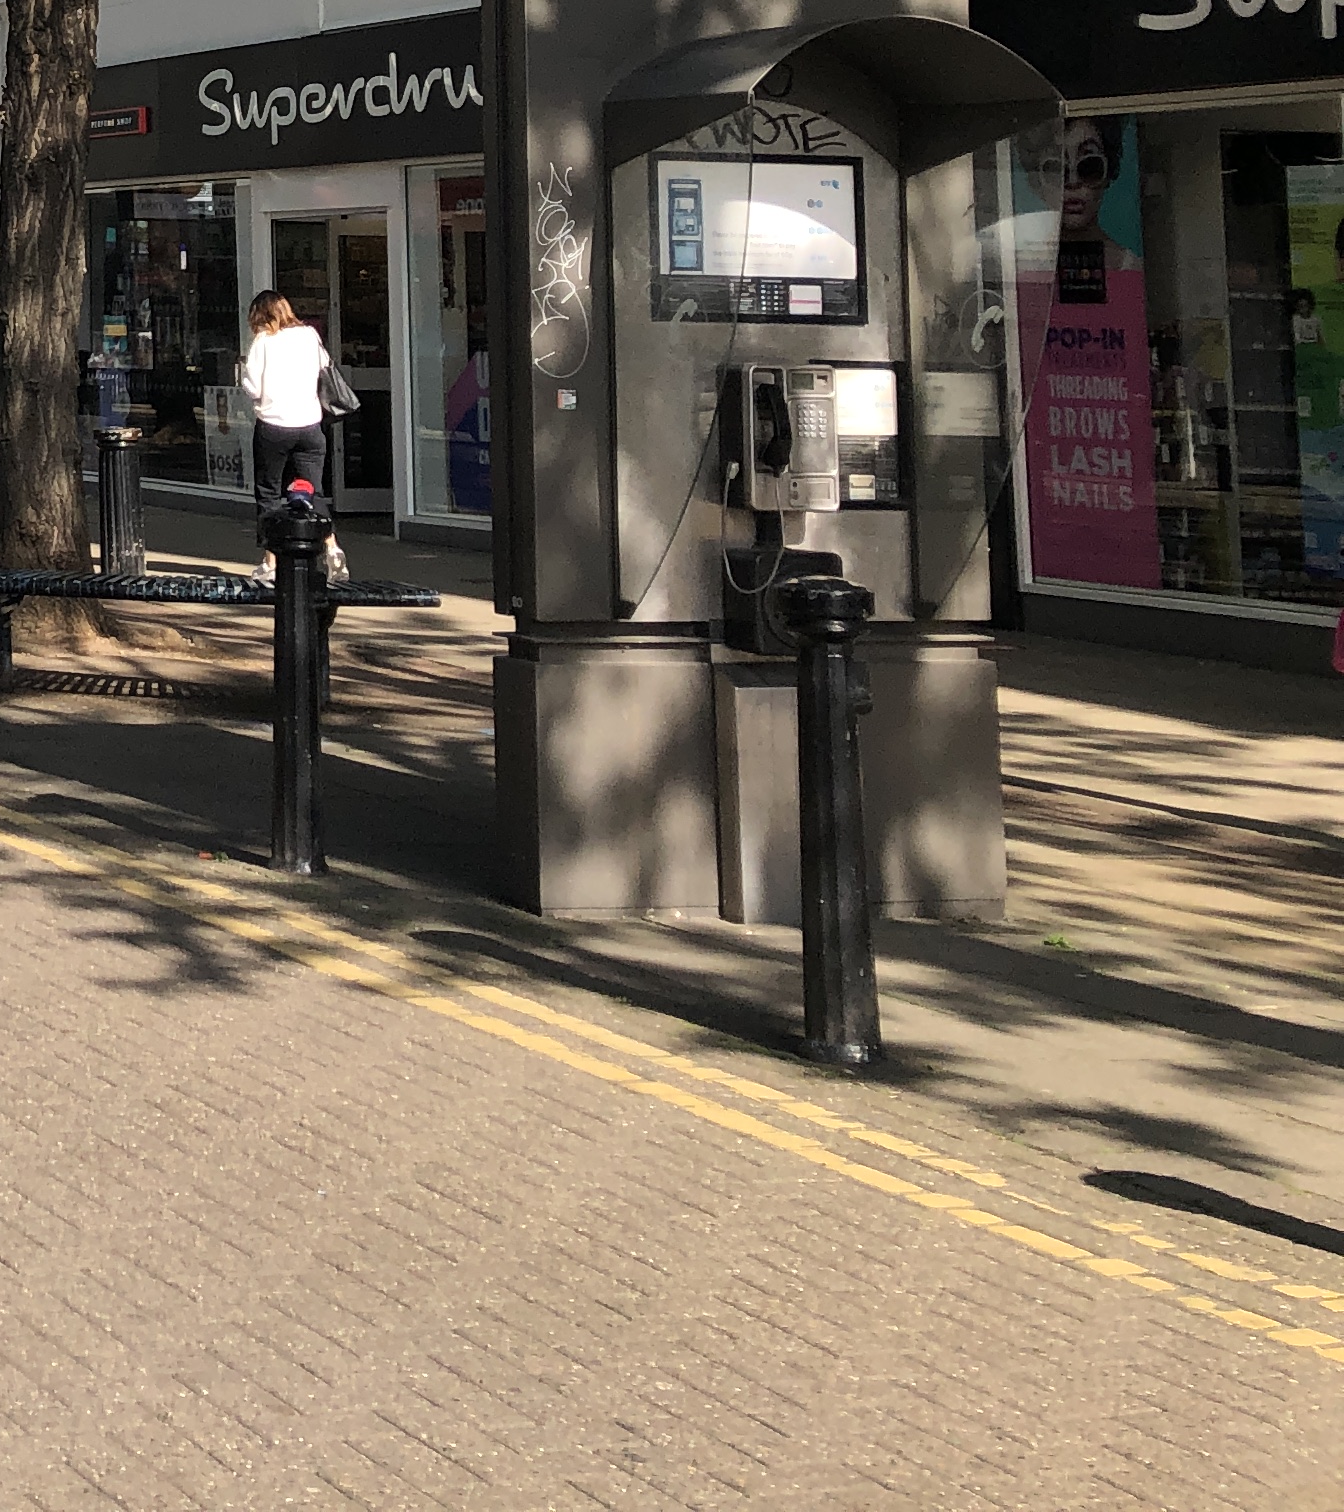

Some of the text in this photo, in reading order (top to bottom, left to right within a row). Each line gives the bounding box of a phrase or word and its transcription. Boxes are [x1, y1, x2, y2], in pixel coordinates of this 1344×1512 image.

[198, 51, 483, 146] Superdru
[1047, 327, 1125, 350] POP-IN
[1047, 374, 1128, 401] THREADING
[1049, 406, 1131, 440] BROWS
[1051, 445, 1133, 478] LASH
[1053, 482, 1135, 512] NAILS
